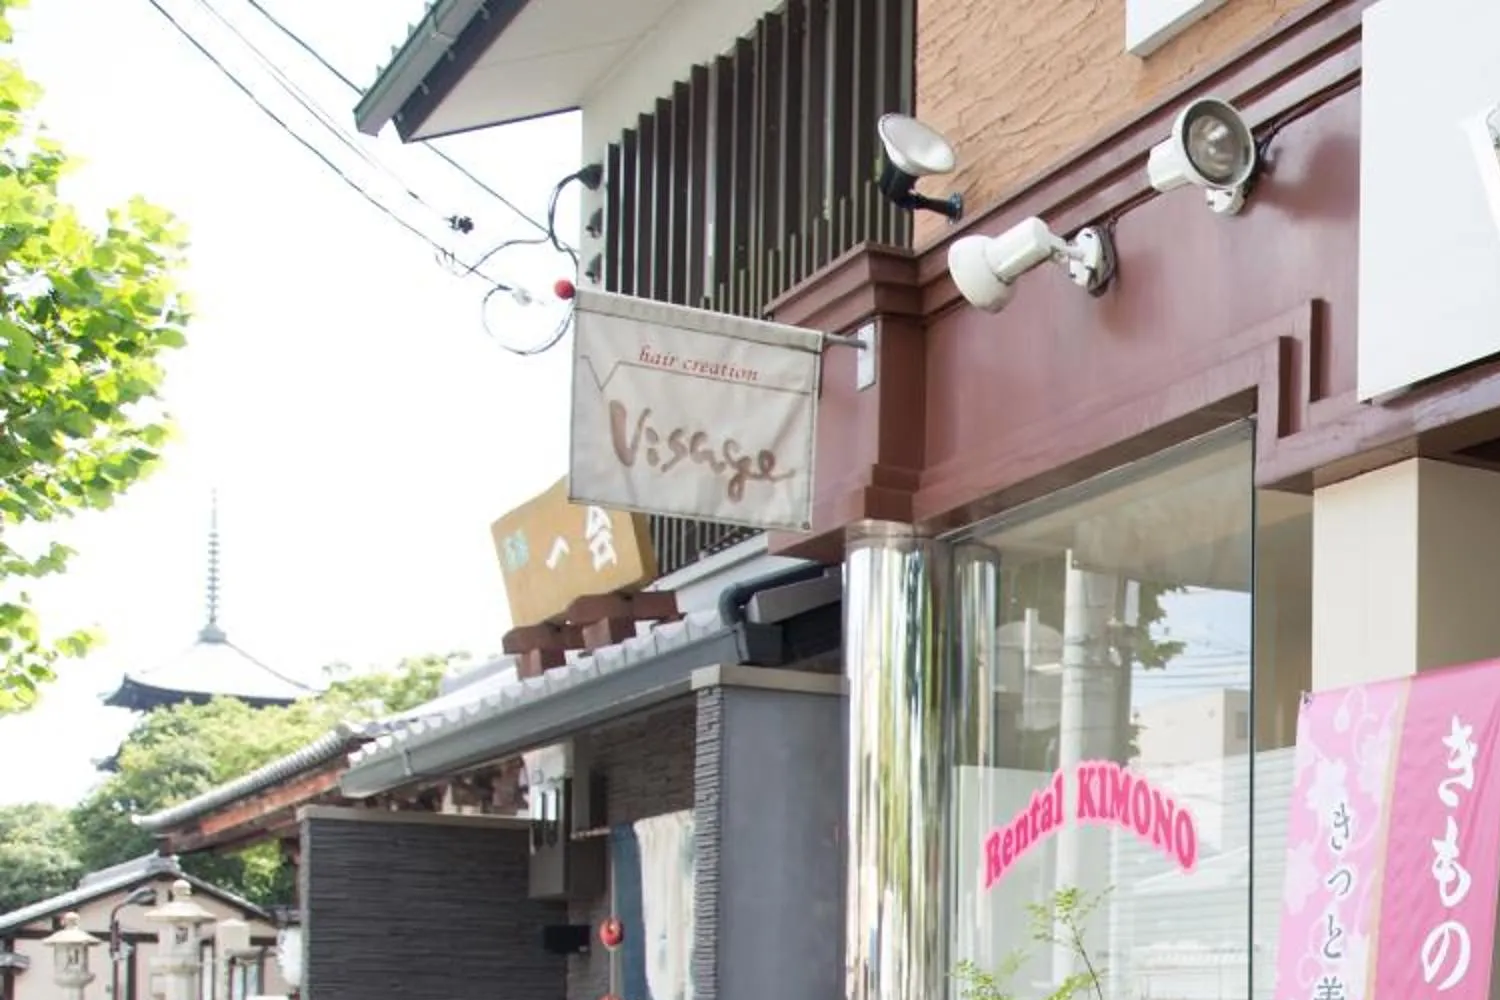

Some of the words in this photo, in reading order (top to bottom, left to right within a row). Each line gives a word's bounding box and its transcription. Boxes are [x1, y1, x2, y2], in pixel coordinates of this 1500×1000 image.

[638, 344, 677, 367] hair
[682, 359, 759, 381] creation
[609, 400, 796, 502] Visage
[984, 769, 1066, 889] Rental
[1076, 761, 1198, 872] KIMONO
